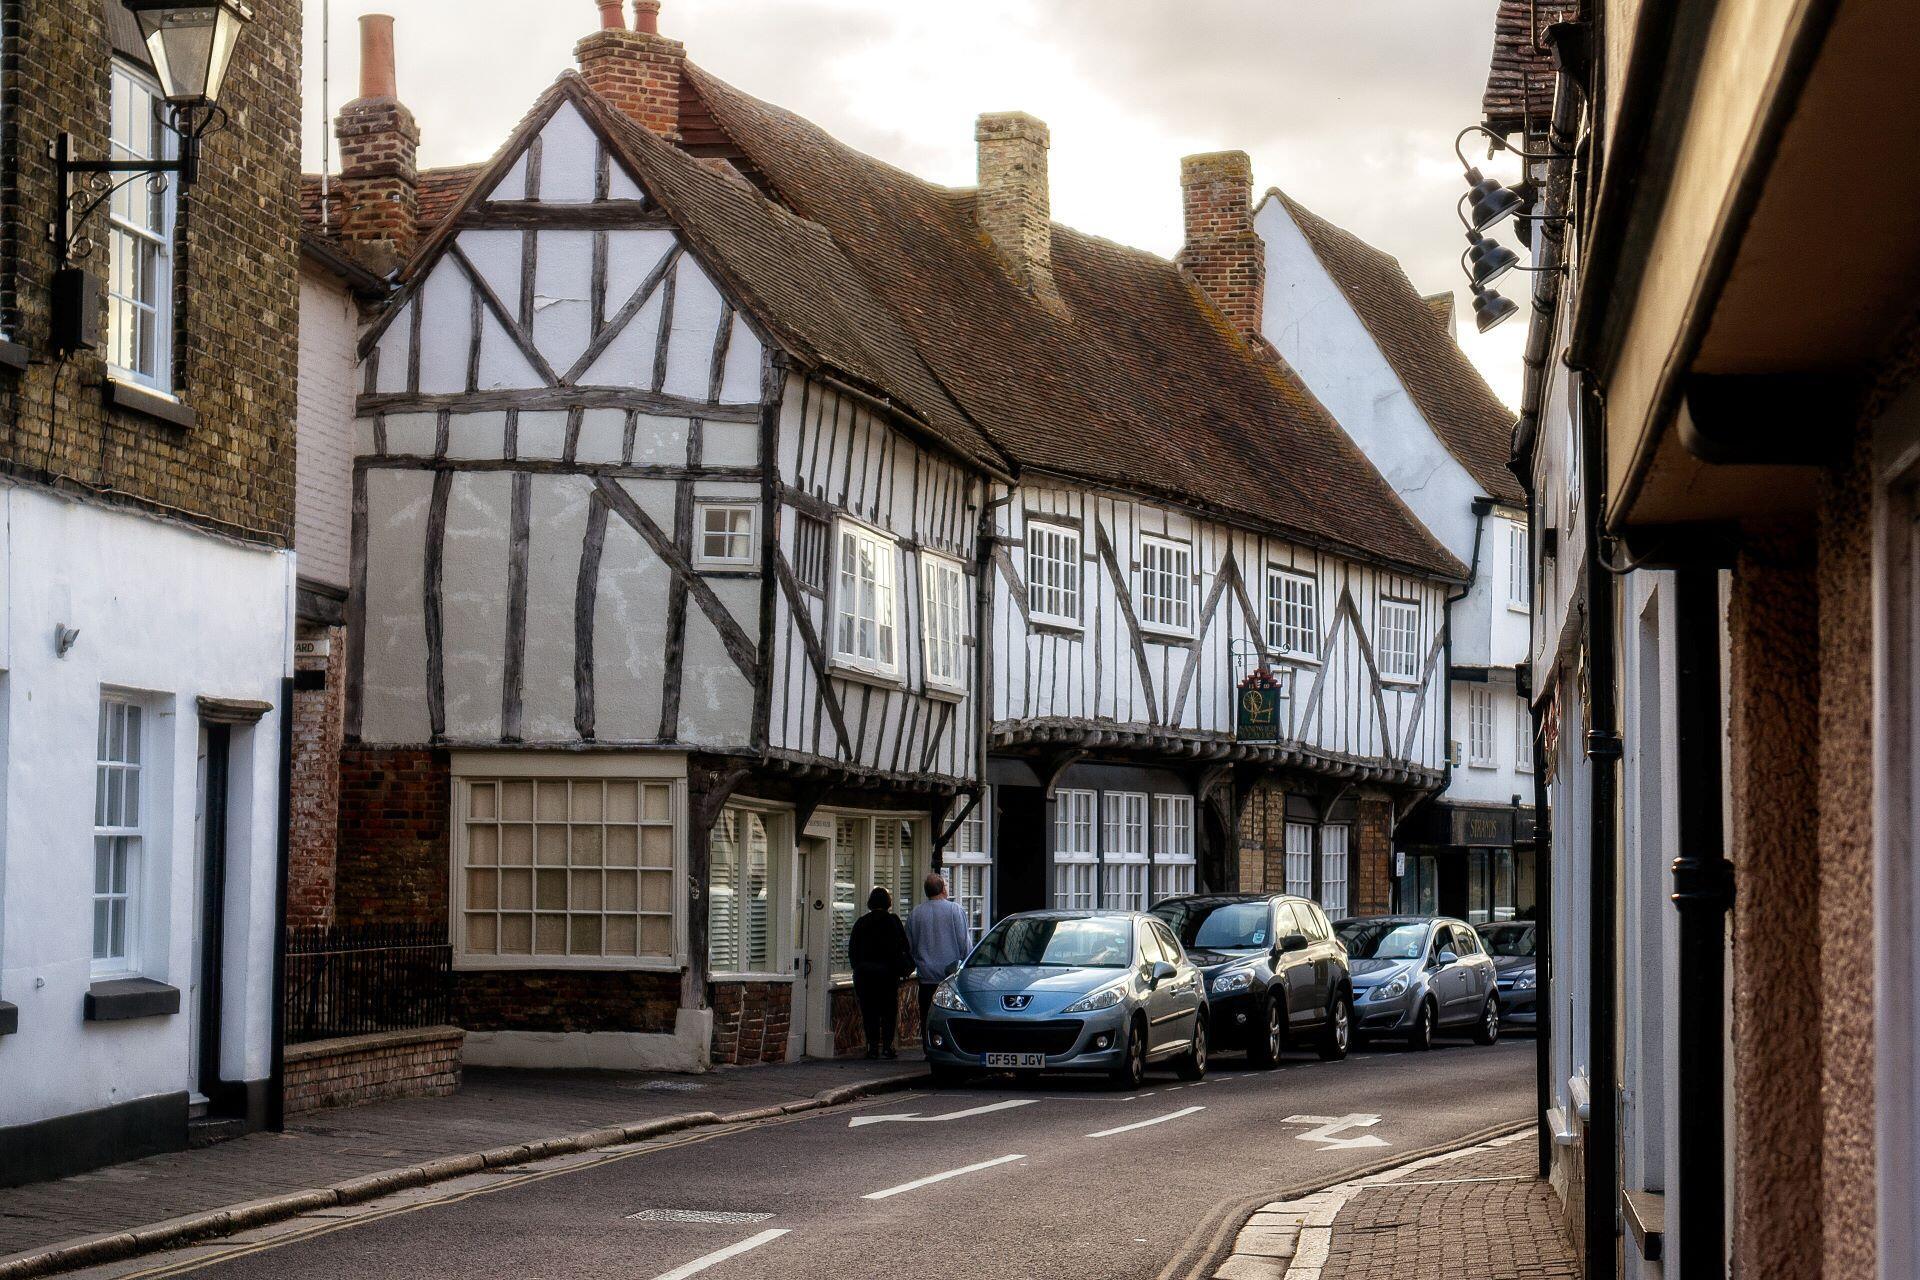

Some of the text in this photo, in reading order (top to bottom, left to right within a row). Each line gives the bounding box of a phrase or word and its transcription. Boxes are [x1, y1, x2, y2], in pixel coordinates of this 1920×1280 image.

[295, 642, 315, 653] ARD
[988, 1054, 1043, 1066] GF59 JGV
